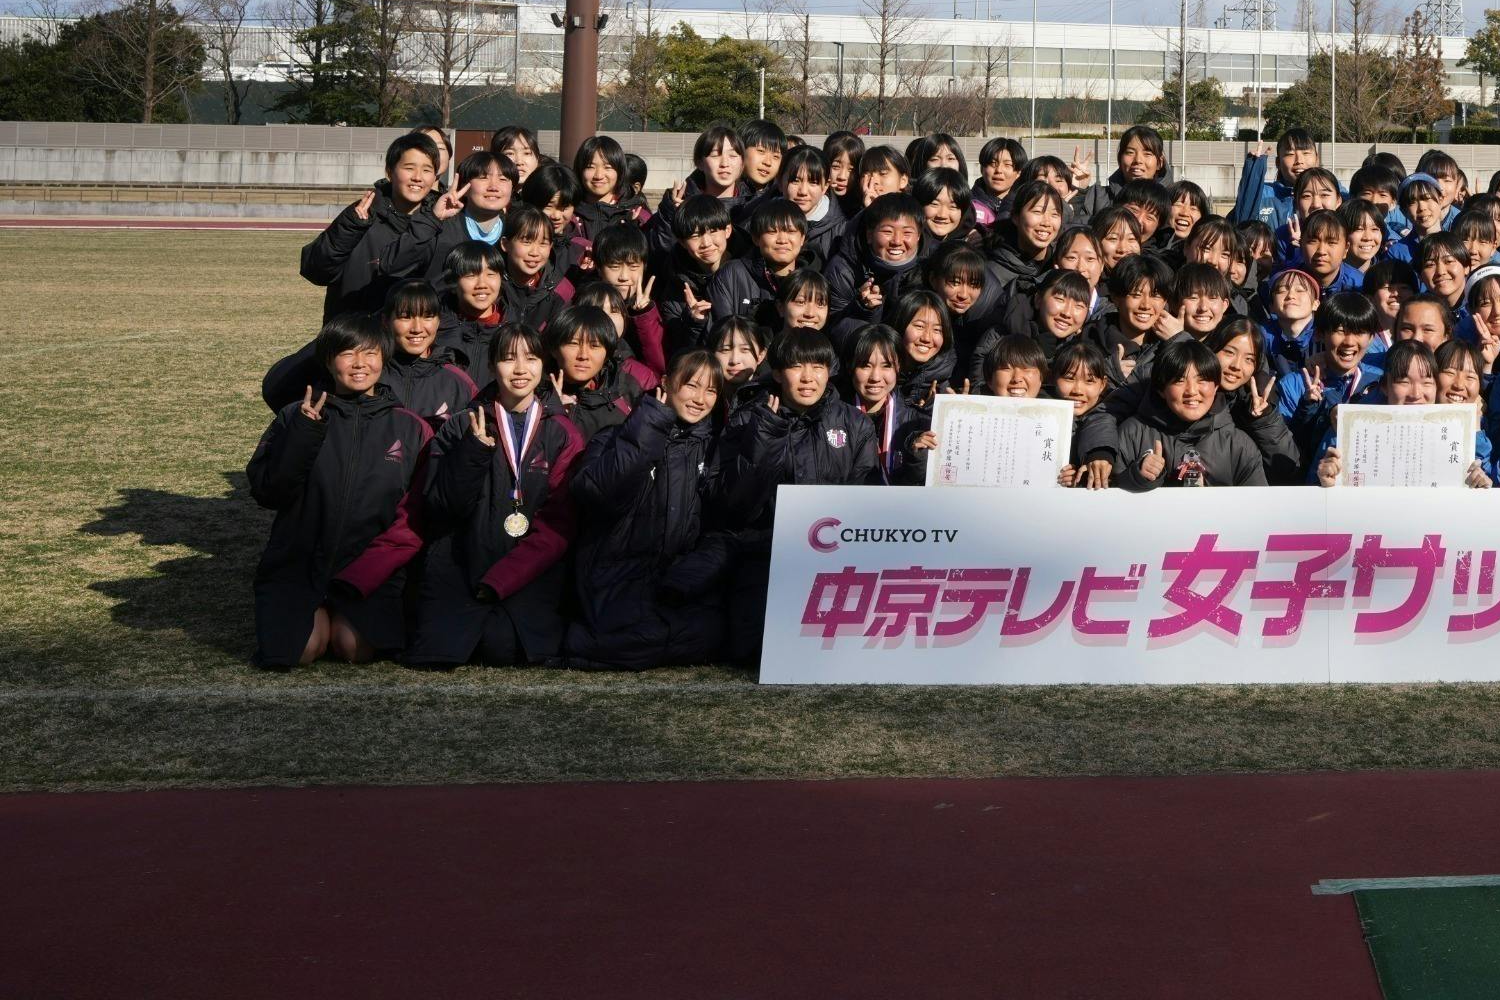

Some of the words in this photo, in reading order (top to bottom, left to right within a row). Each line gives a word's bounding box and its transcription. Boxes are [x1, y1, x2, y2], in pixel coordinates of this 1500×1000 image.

[1042, 437, 1054, 462] 賞状
[1448, 441, 1460, 464] 賞状
[840, 528, 927, 543] CHUKYO
[931, 529, 959, 543] TV
